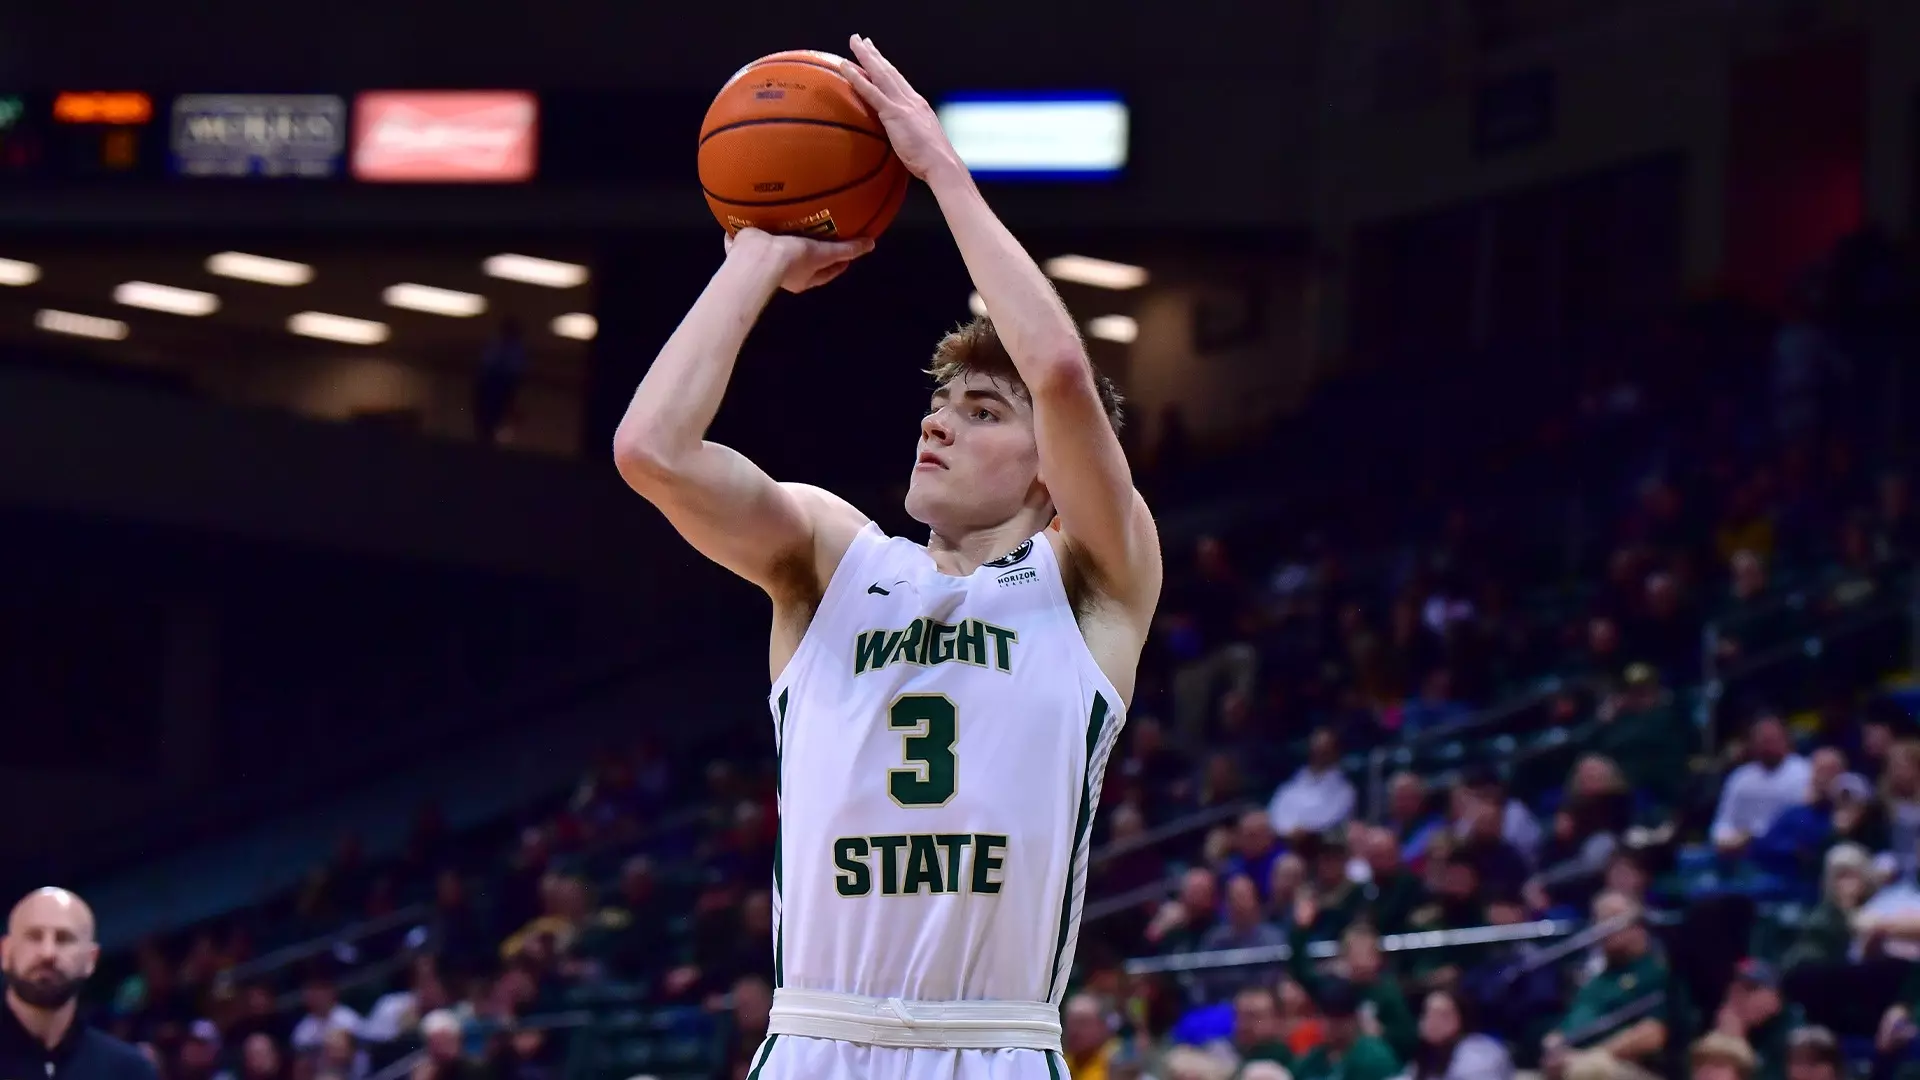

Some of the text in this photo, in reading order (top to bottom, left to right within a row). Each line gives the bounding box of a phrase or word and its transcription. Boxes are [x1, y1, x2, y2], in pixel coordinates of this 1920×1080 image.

[997, 570, 1037, 584] HORIZON
[854, 616, 1018, 677] WRIGHT
[887, 693, 959, 809] 3
[833, 833, 1009, 898] STATE
